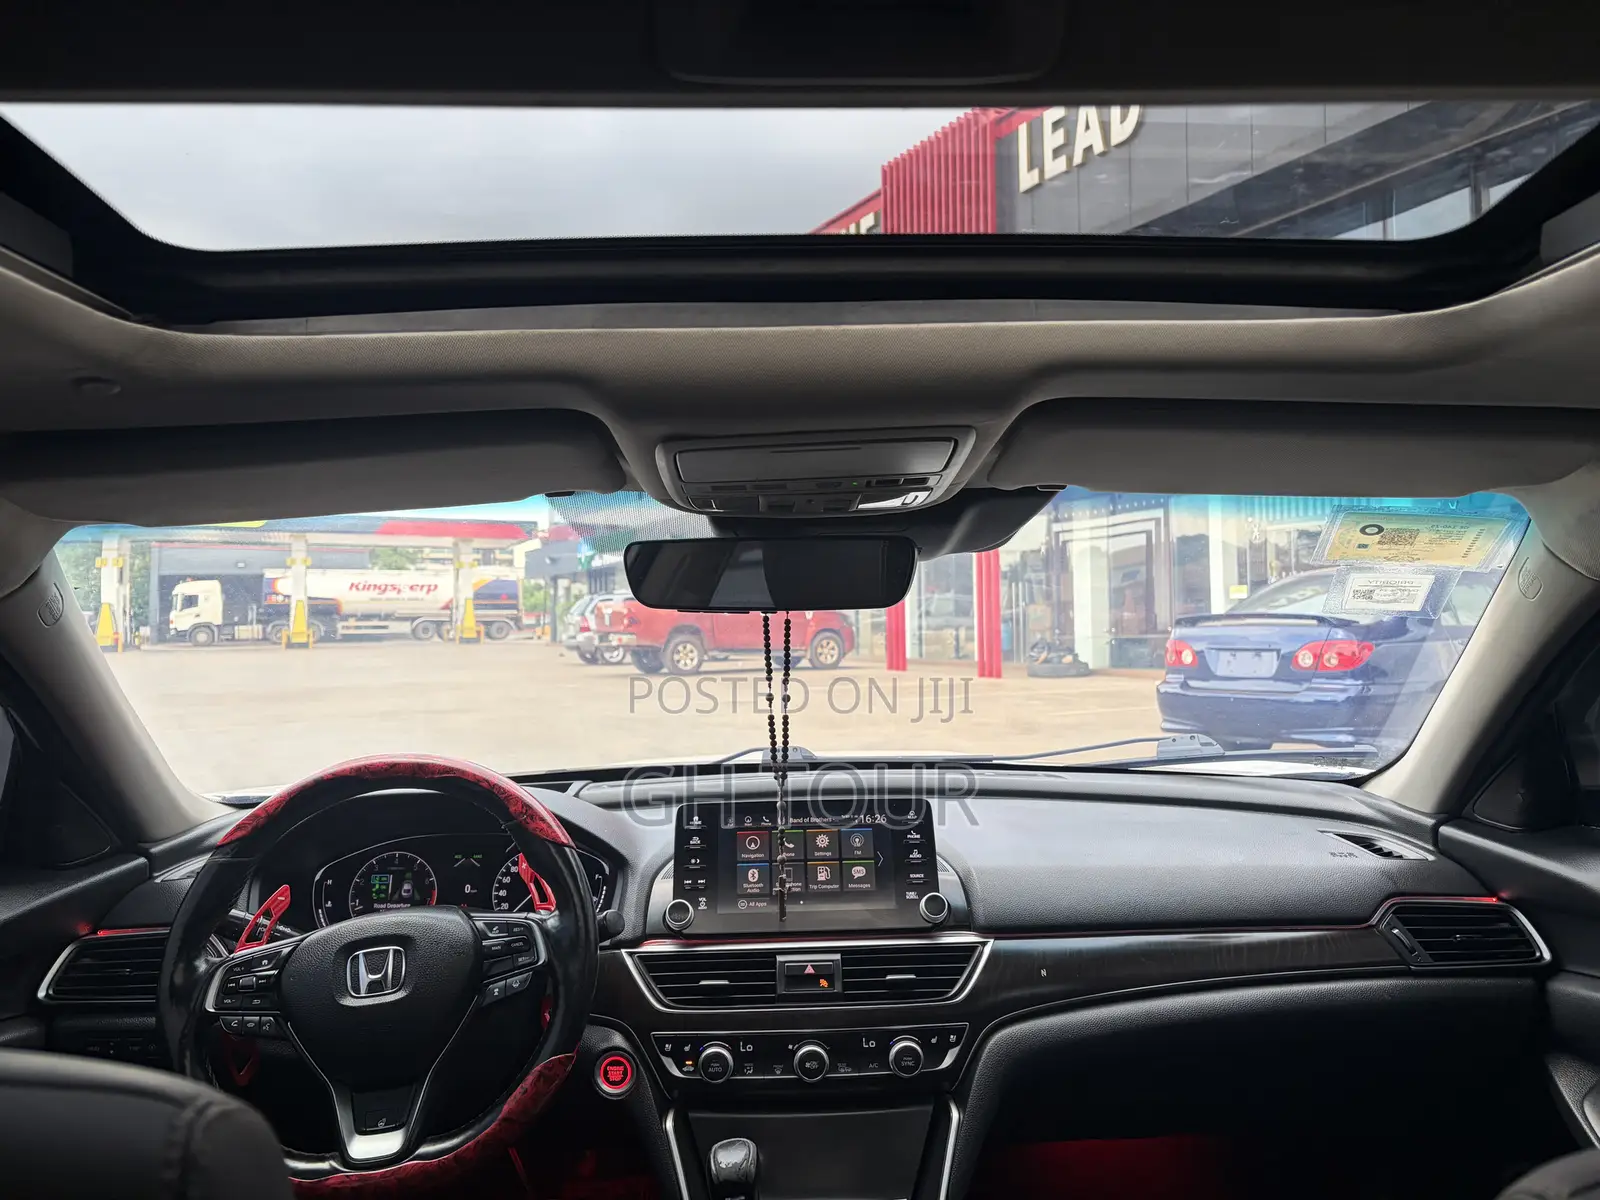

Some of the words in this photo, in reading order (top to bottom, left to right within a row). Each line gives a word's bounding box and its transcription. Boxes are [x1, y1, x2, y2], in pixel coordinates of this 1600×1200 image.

[1018, 105, 1141, 194] LEAD
[859, 814, 887, 824] 16:26
[502, 876, 511, 884] 60
[464, 883, 471, 893] 0
[498, 889, 507, 897] 40
[740, 1042, 753, 1052] Lo
[862, 1037, 876, 1048] Lo
